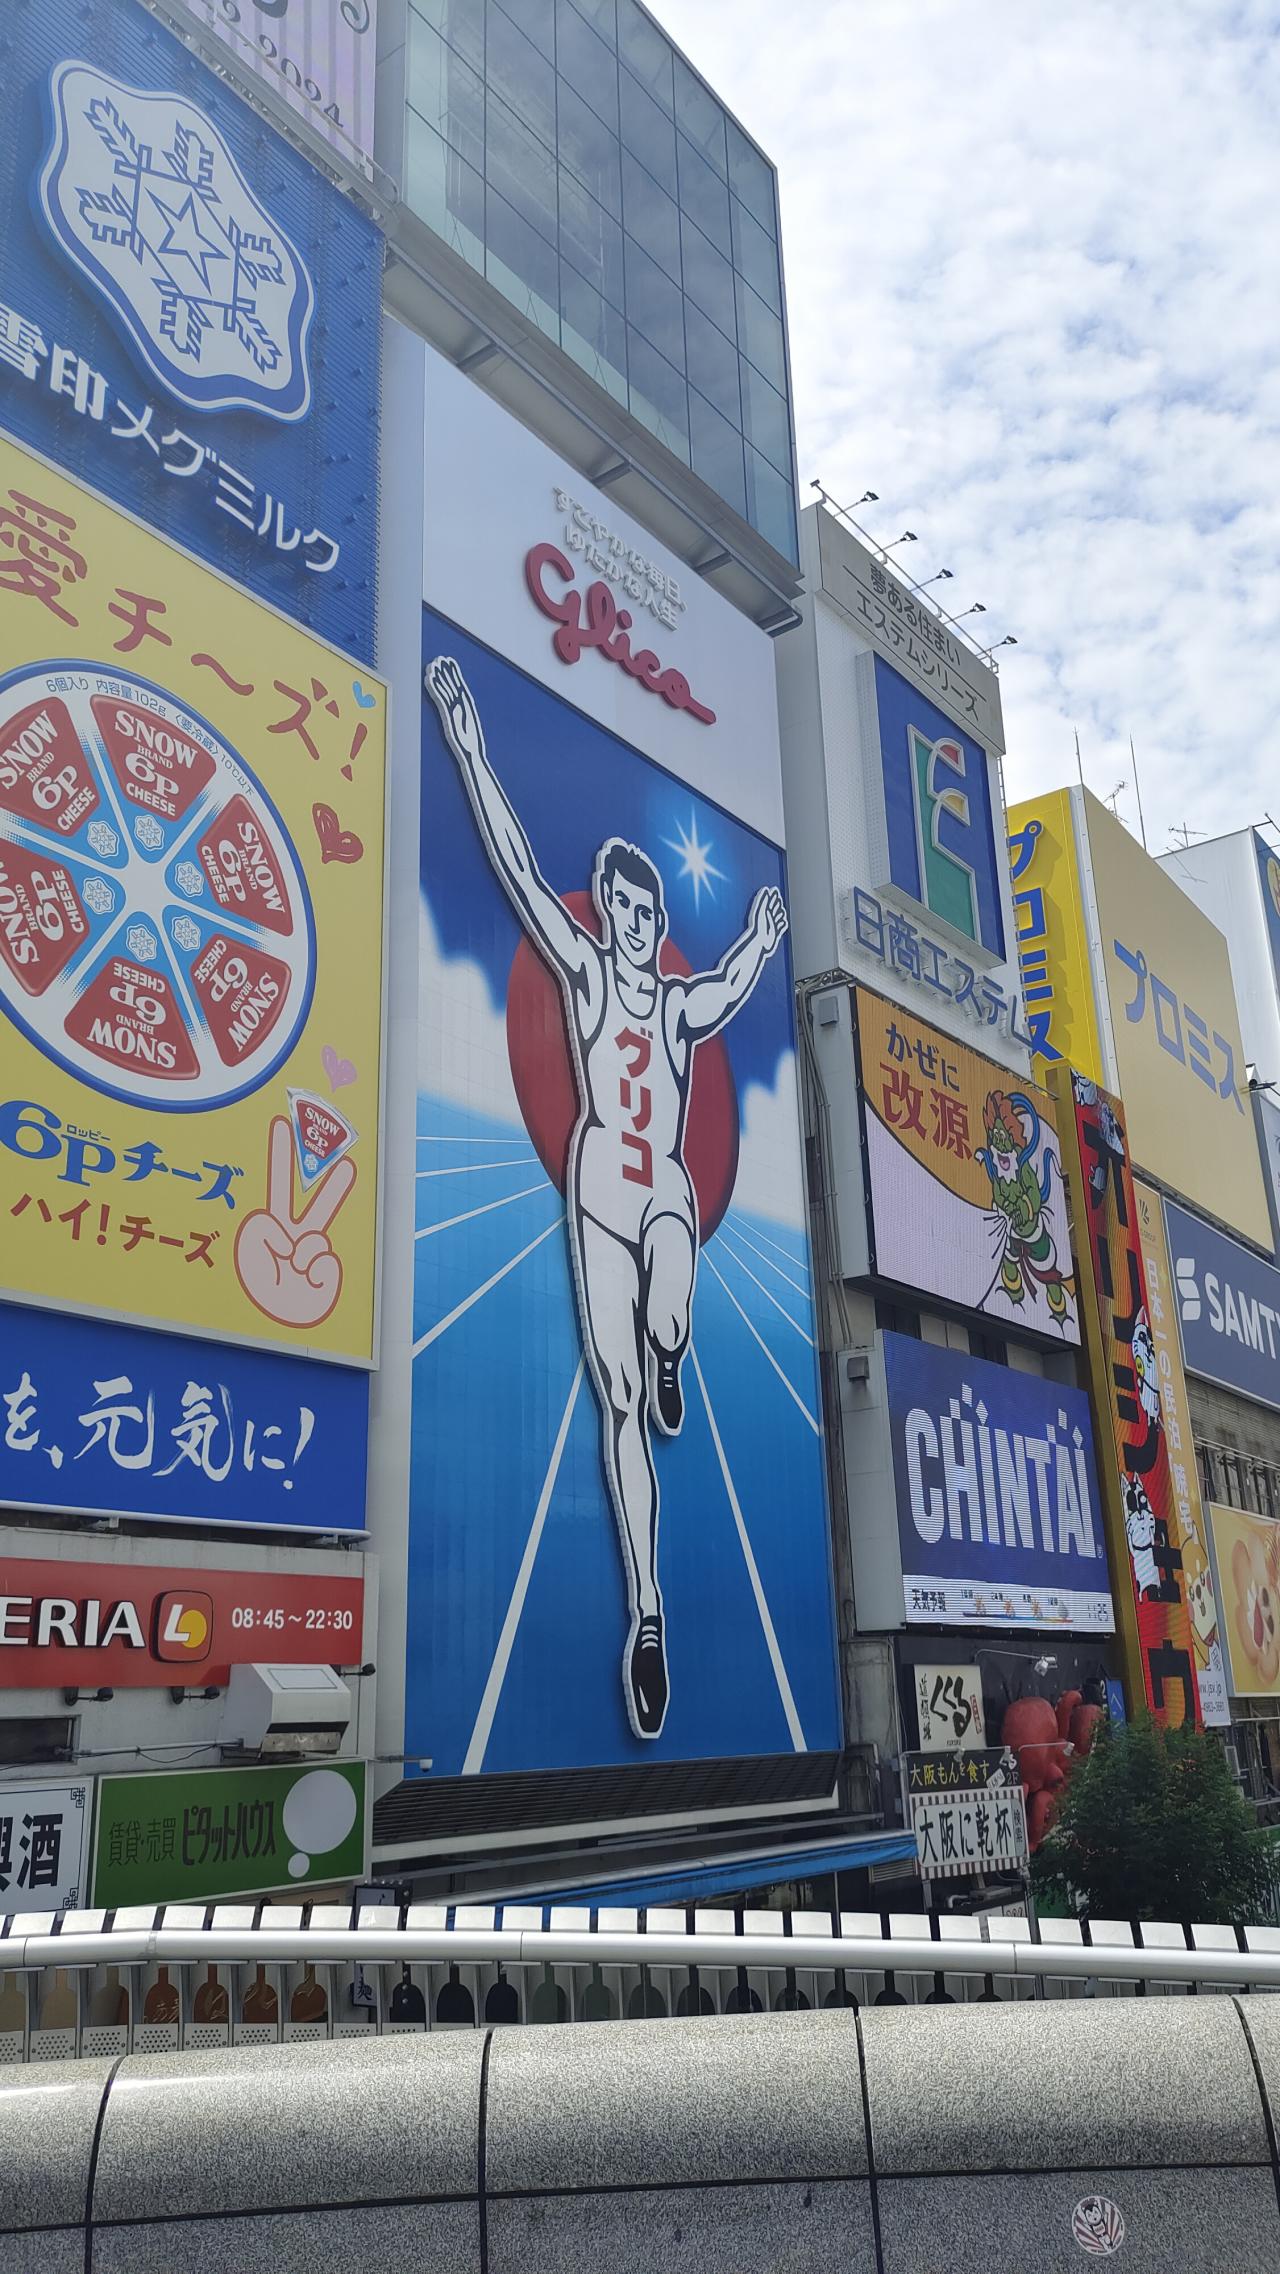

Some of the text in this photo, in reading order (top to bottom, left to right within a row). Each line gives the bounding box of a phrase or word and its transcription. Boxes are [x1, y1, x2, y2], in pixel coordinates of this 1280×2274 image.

[0, 302, 340, 573] 雪印メグミルク
[525, 542, 717, 726] Glico
[869, 562, 961, 667] 夢ある住まい
[45, 676, 90, 693] 6個入り
[856, 590, 979, 722] エステムシリーズ
[0, 709, 58, 790] SNOW
[26, 751, 55, 784] BRAND
[114, 710, 199, 769] SNOW
[136, 744, 174, 769] BRAND
[32, 764, 78, 810] 6P
[125, 751, 180, 799] 6P
[125, 782, 177, 817] CHEESE
[57, 786, 97, 831] CHEESE
[201, 845, 230, 904] CHEESE
[218, 839, 247, 902] 6P
[237, 821, 286, 914] SNOW
[238, 848, 258, 890] BRAND
[0, 860, 41, 965] SNO
[15, 884, 39, 931] BRAND
[30, 870, 64, 941] 6P
[51, 869, 85, 934] CHEESE
[113, 962, 166, 993] CHEESE
[194, 938, 228, 984] CHEESE
[210, 957, 249, 1002] 6P
[109, 981, 167, 1026] 6P
[116, 1014, 155, 1036] BRAND
[227, 972, 280, 1053] SNOW
[230, 980, 254, 1012] BRAND
[87, 1018, 177, 1070] SNOW
[885, 1021, 961, 1093] かぜに
[1113, 938, 1246, 1117] プロミス
[66, 1123, 112, 1142] ロッピー
[304, 1107, 341, 1137] SNOW
[306, 1125, 329, 1148] 6P
[613, 1026, 654, 1189] グリコ
[879, 1062, 974, 1161] 改源
[905, 1382, 1097, 1559] CHINTAI
[0, 1596, 146, 1648] ERIA
[930, 1675, 971, 1738] くくる
[181, 1800, 277, 1867] ピタットハウス
[918, 1803, 1013, 1865] 大阪に乾杯
